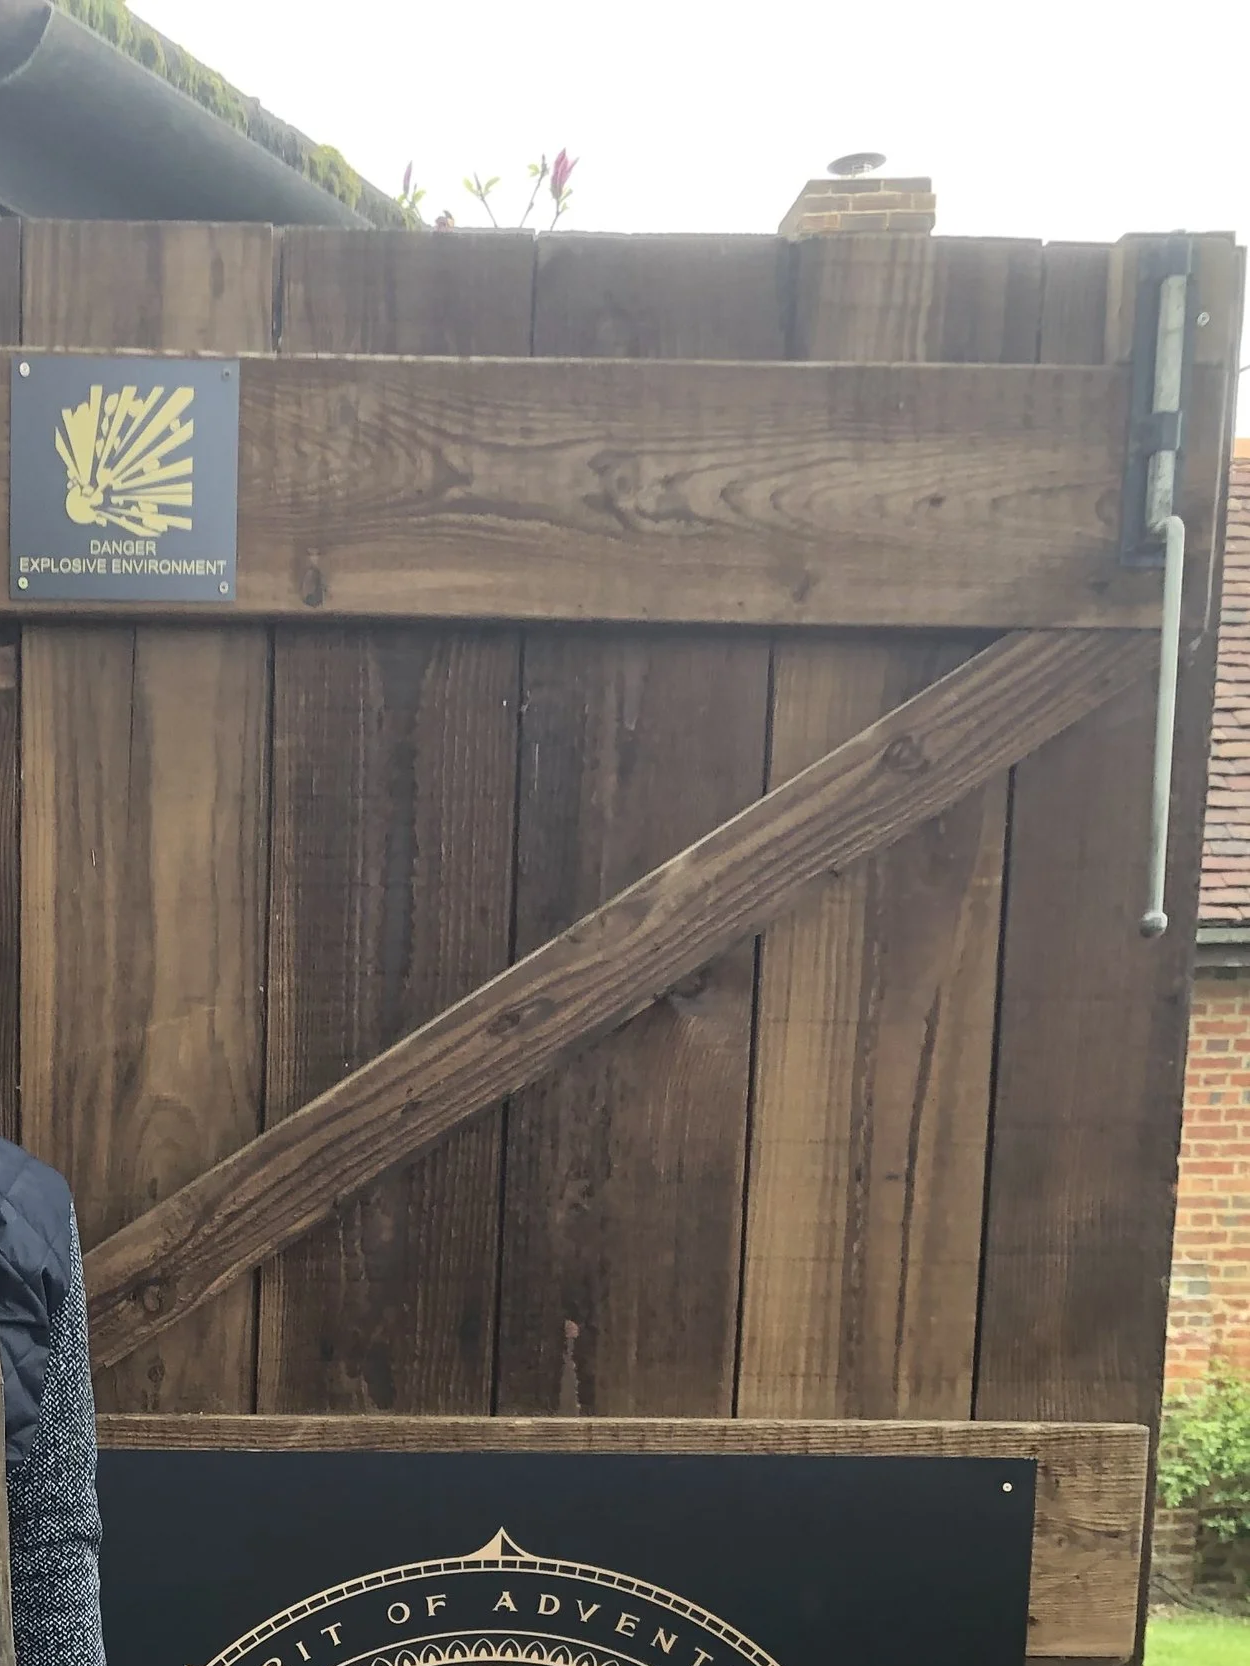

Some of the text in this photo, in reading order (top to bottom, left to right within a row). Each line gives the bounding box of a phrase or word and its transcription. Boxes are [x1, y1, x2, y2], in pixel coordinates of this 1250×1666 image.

[90, 540, 156, 556] DANGER
[19, 557, 227, 575] EXPLOSIVE ENVIRONMENT
[387, 1592, 448, 1624] OF
